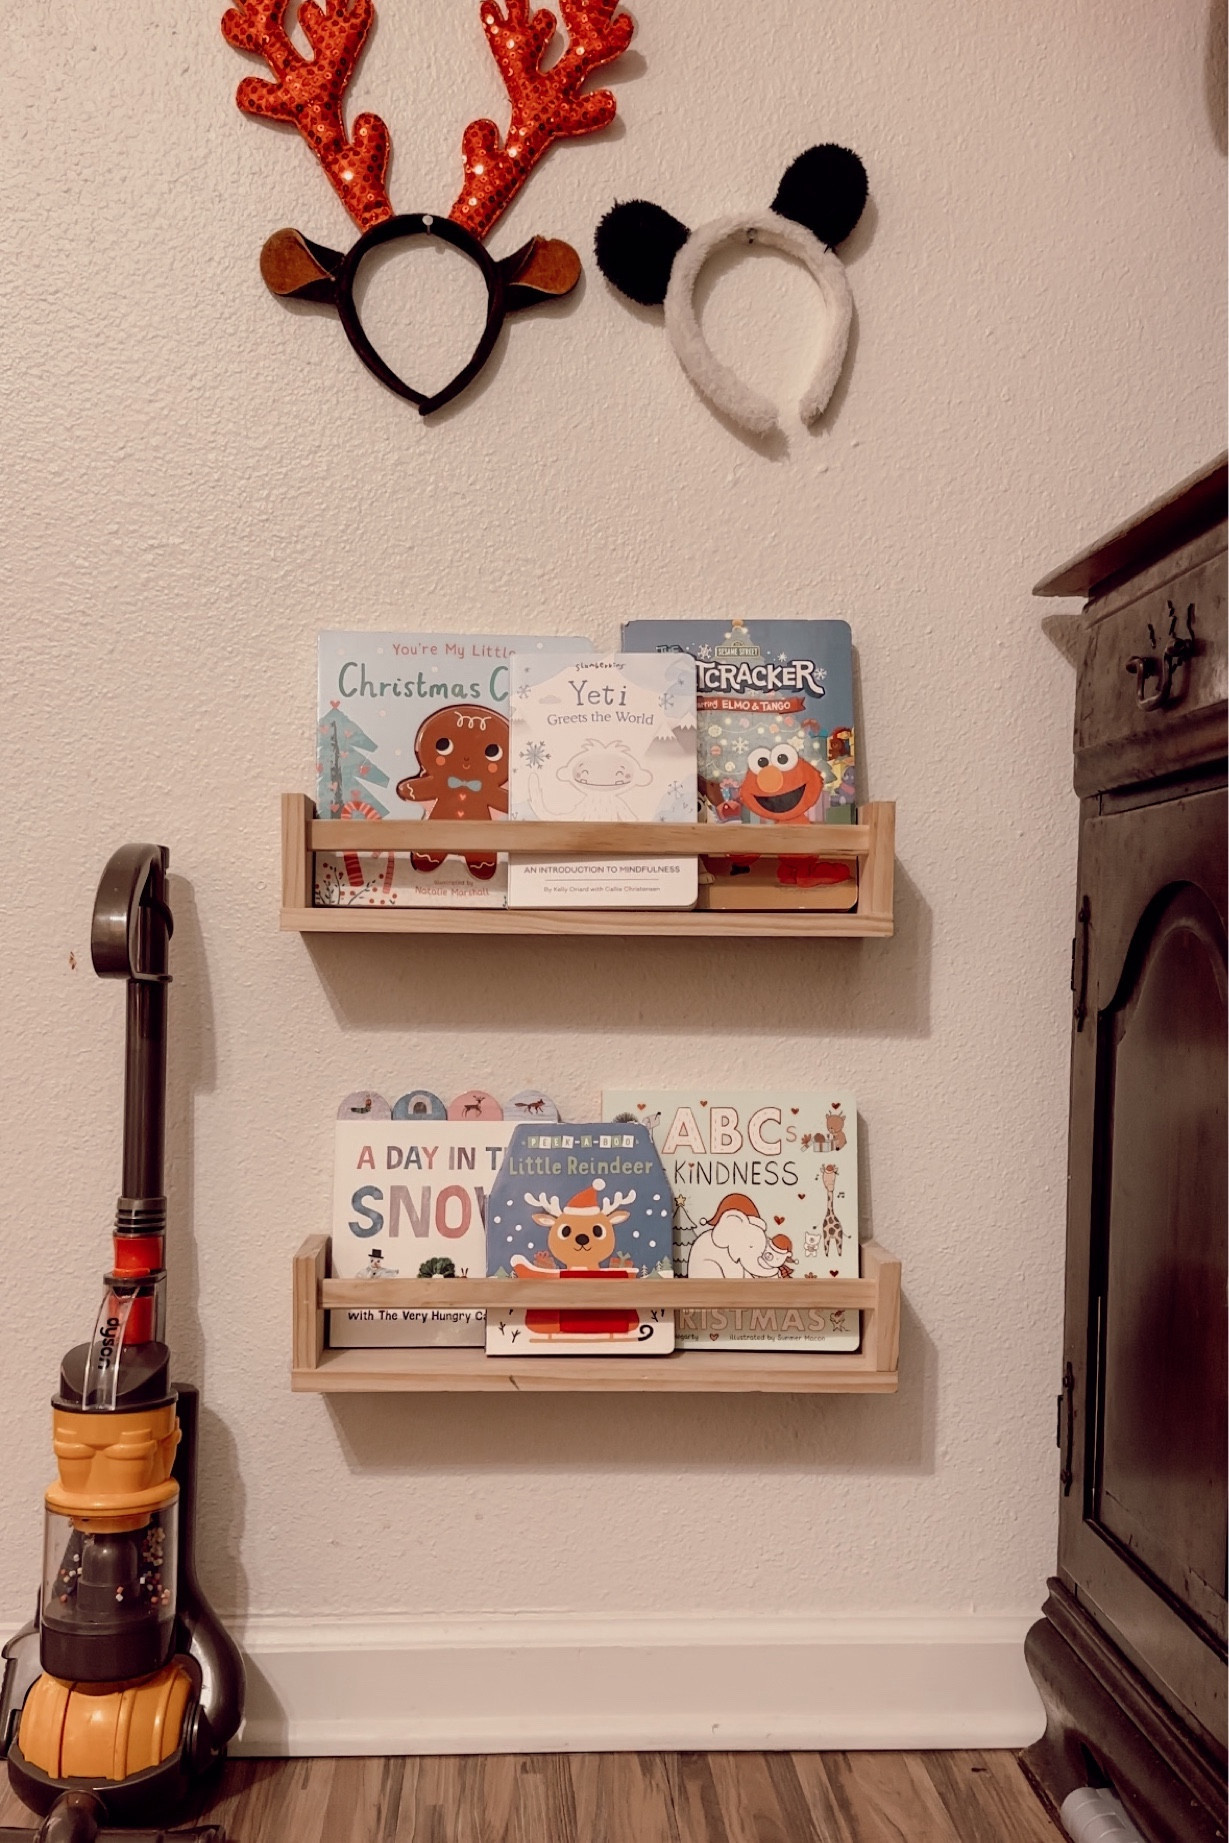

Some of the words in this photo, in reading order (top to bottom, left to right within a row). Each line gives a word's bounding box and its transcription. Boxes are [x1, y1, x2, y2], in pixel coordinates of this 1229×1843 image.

[392, 643, 438, 656] You're
[445, 643, 465, 659] My
[338, 661, 481, 699] Christmas
[489, 665, 509, 702] C
[695, 660, 825, 695] TCRACKER
[568, 680, 627, 706] Yeti
[722, 700, 750, 709] ELMO
[752, 702, 759, 711] &
[760, 701, 791, 711] TANGO
[547, 713, 588, 726] Greets
[591, 711, 611, 722] the
[615, 711, 654, 725] World
[523, 866, 537, 874] AN
[539, 866, 605, 874] INTRODUCTION
[607, 865, 618, 873] TO
[619, 865, 681, 874] MINDFULNESS
[415, 886, 448, 896] Natalie
[451, 888, 490, 897] Marshall
[356, 1145, 376, 1170] A
[386, 1145, 439, 1170] DAY
[448, 1146, 476, 1171] IN
[485, 1146, 503, 1171] T
[509, 1157, 562, 1175] Little
[567, 1156, 653, 1175] Reindeer
[348, 1310, 374, 1321] with
[379, 1310, 398, 1320] The
[402, 1311, 428, 1323] Very
[431, 1310, 471, 1323] Hungry
[474, 1311, 487, 1321] C
[679, 1309, 826, 1332] RISTMAS
[98, 1317, 120, 1370] dyson
